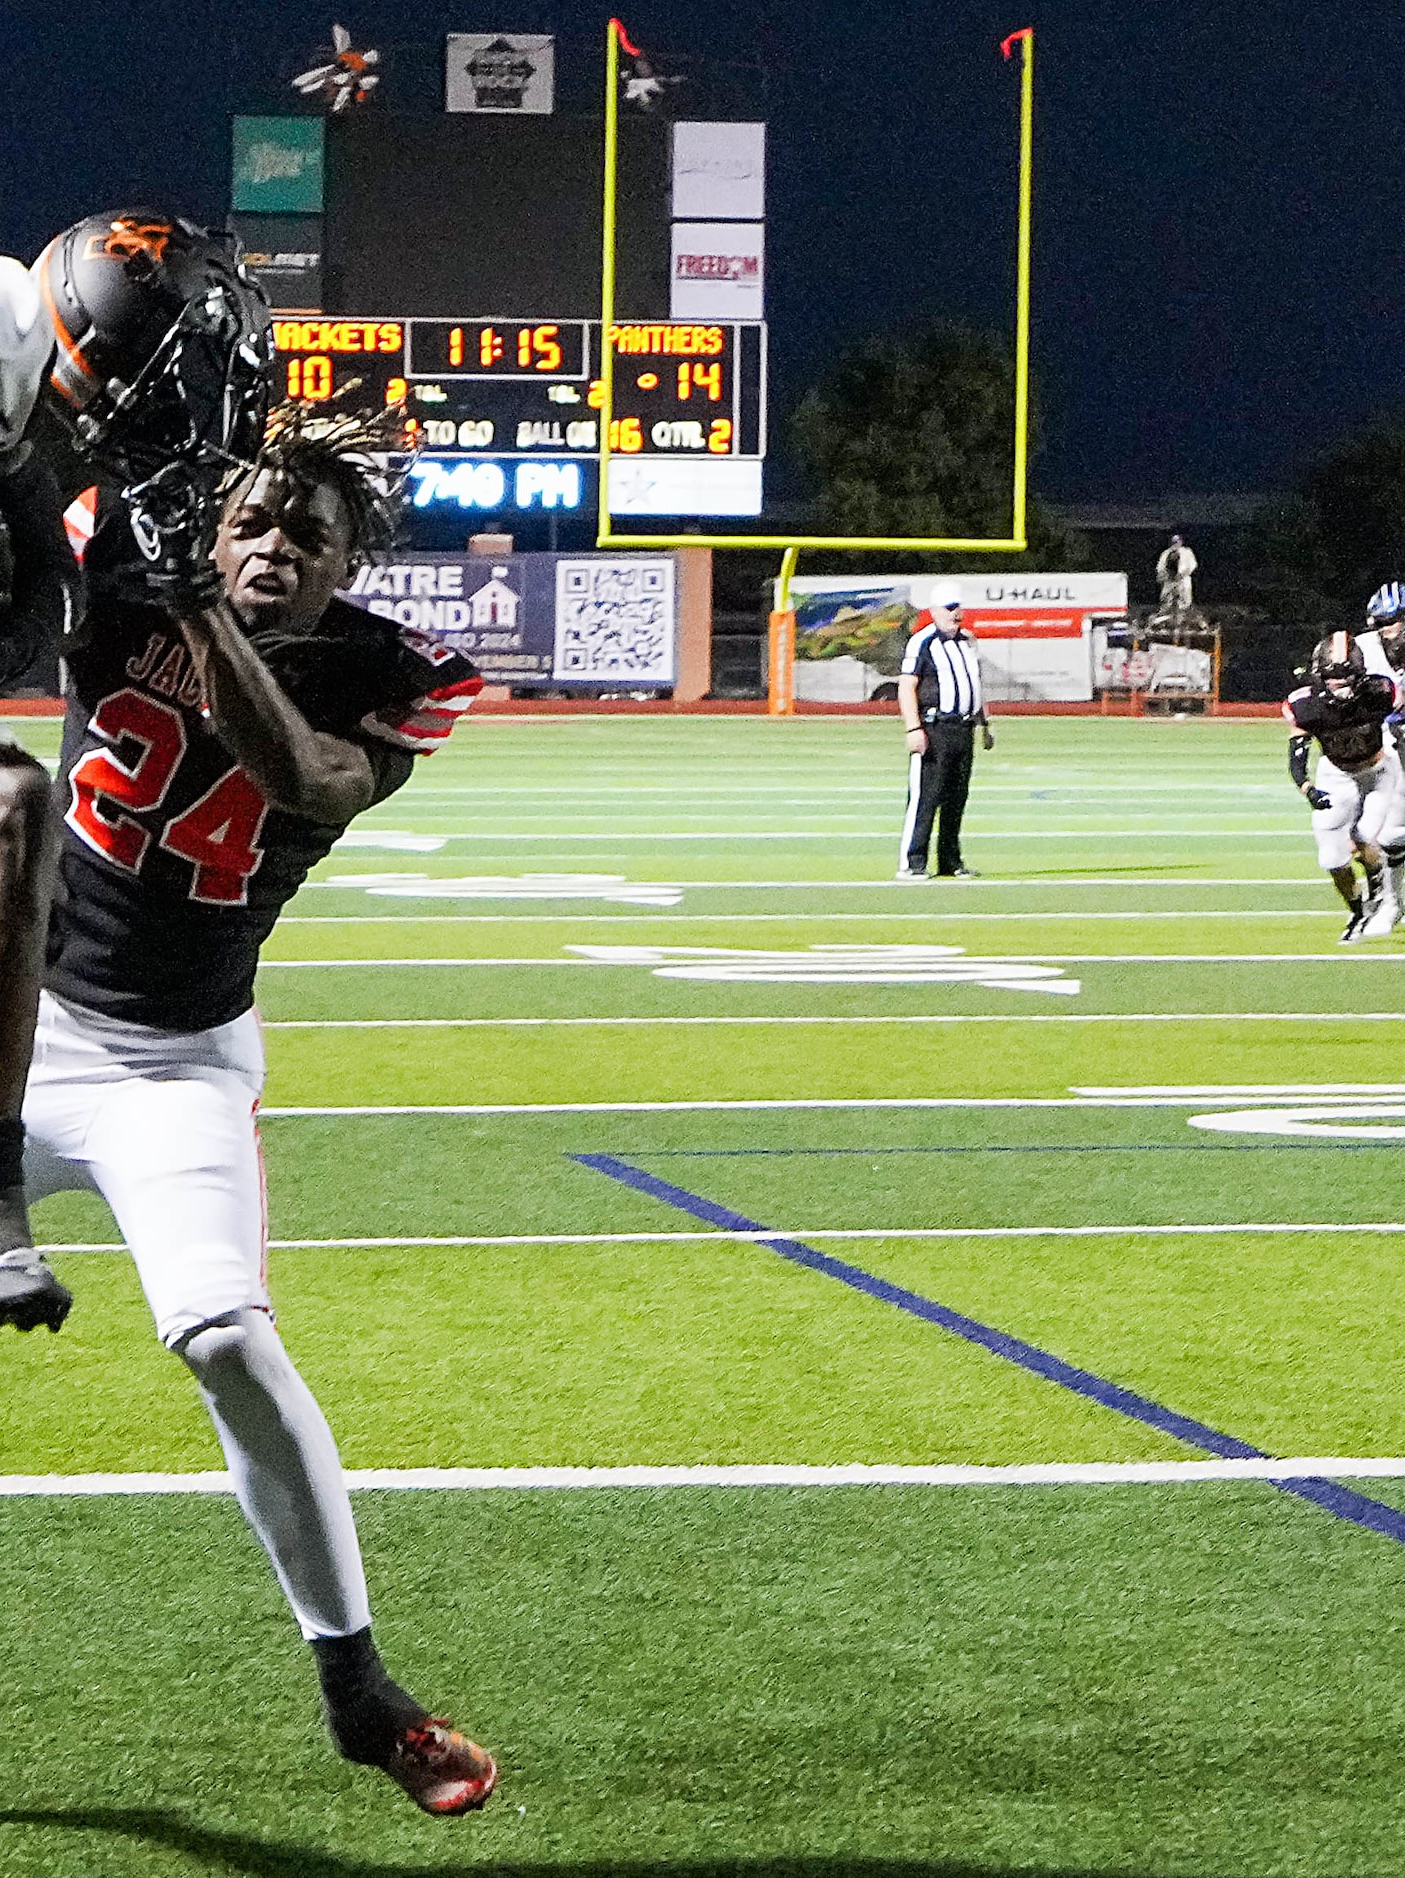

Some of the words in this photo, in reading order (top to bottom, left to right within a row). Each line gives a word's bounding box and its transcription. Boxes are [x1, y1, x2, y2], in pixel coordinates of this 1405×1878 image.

[449, 325, 563, 370] 11:15
[608, 325, 723, 354] PANTHERS
[287, 356, 333, 400] 10
[588, 380, 606, 409] 2
[677, 362, 722, 401] 14
[423, 420, 456, 445] TO
[458, 420, 494, 447] GO
[516, 421, 565, 447] BALL
[708, 419, 732, 453] 2
[517, 463, 579, 506] PM
[985, 586, 1077, 601] U-HAUL
[64, 687, 270, 906] 24
[563, 944, 1066, 983] 20
